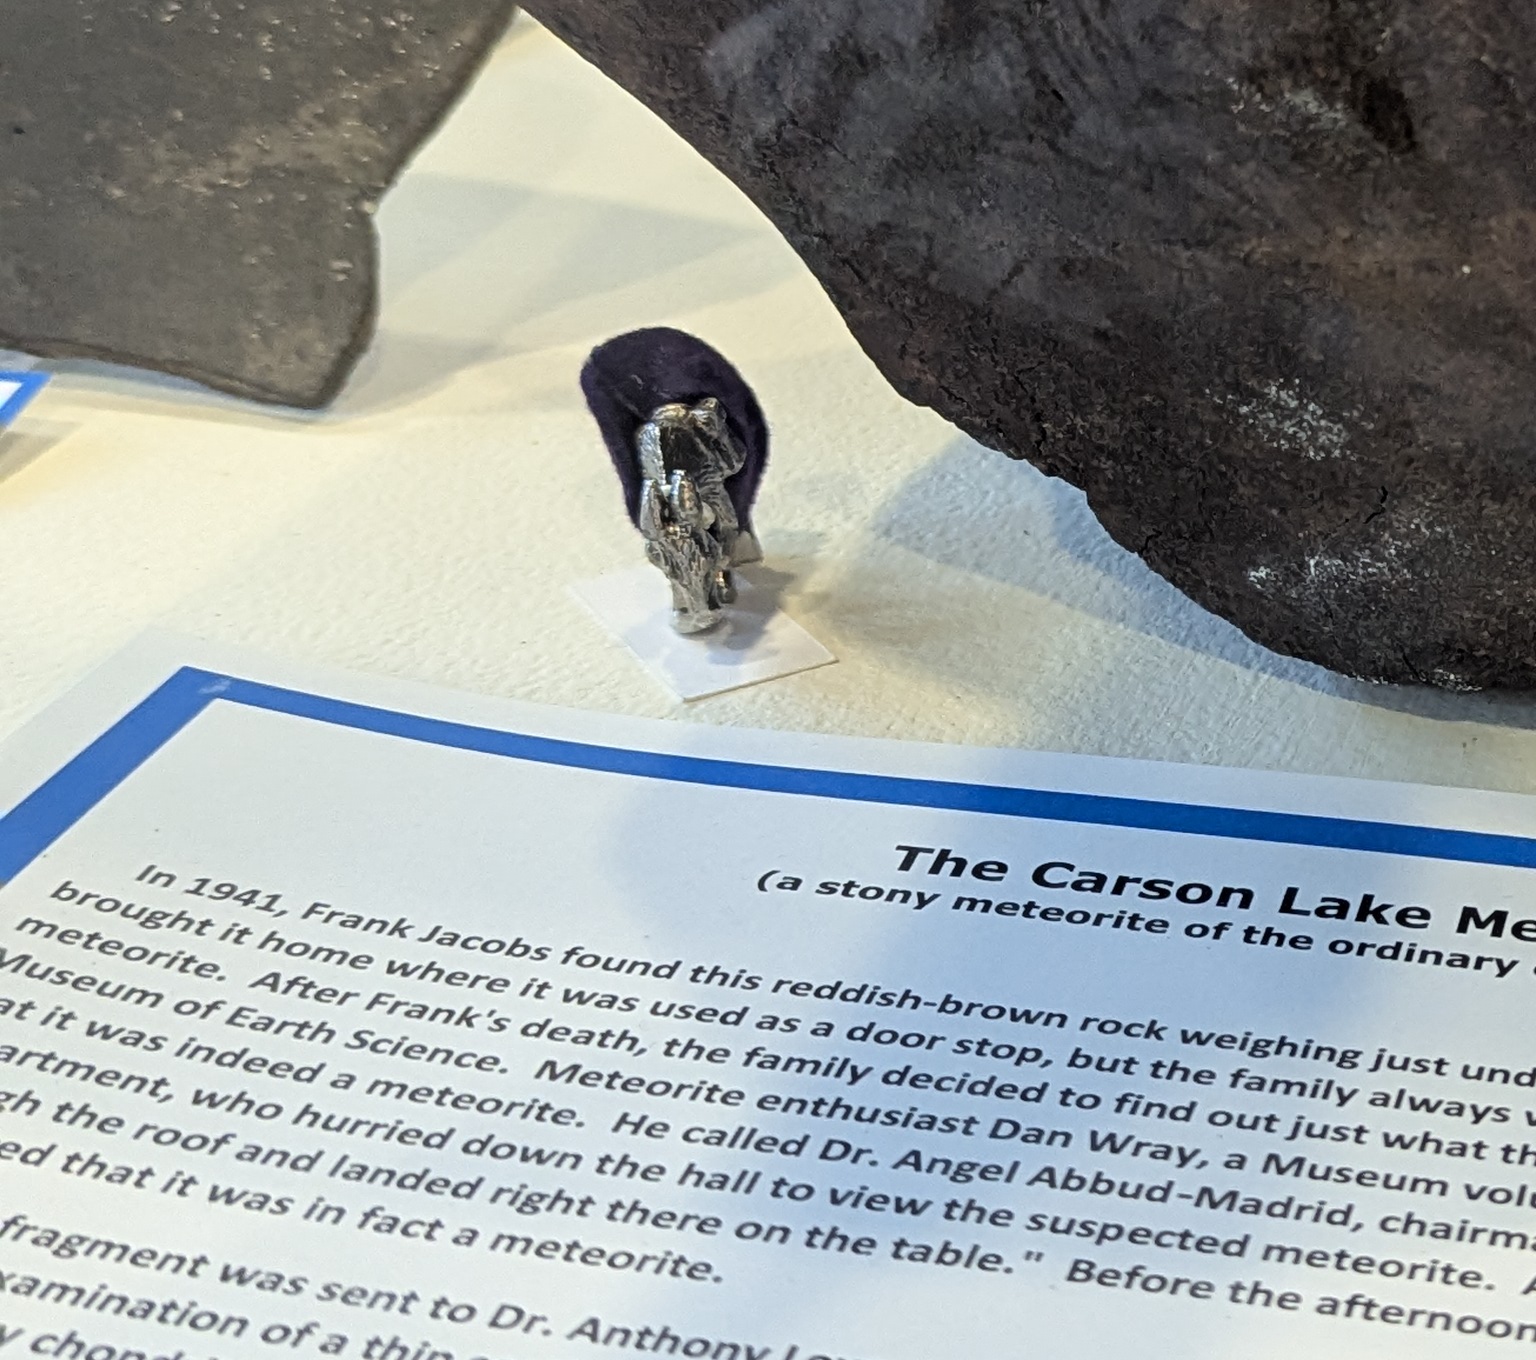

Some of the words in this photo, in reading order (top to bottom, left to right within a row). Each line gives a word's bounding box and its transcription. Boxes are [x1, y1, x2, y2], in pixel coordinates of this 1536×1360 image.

[182, 876, 289, 918] 1941,
[299, 900, 415, 939] Frank
[415, 924, 553, 962] Jacobs
[559, 945, 683, 980] found
[688, 963, 763, 991] this
[770, 978, 1069, 1029] reddish-brown
[1077, 1015, 1169, 1042] rock
[1179, 1027, 1364, 1070] weighing
[1366, 1046, 1451, 1077] just
[756, 868, 803, 893] (a
[813, 879, 942, 911] stony
[950, 894, 1170, 934] meteorite
[1182, 920, 1234, 941] of
[1241, 924, 1314, 951] the
[1326, 938, 1520, 979] ordinary
[894, 843, 1009, 882] The
[1030, 860, 1255, 911] Carson
[1276, 885, 1432, 930] Lake
[14, 916, 226, 982] meteorite.
[246, 970, 361, 1006] After
[363, 991, 512, 1033] Frank's
[519, 1017, 647, 1057] death,
[661, 1036, 731, 1064] the
[740, 1045, 875, 1086] family
[880, 1063, 1050, 1104] decided
[1112, 1091, 1198, 1123] find
[1282, 1113, 1371, 1146] just
[1381, 1129, 1490, 1161] what
[48, 879, 215, 937] brought
[255, 929, 374, 970] home
[384, 958, 511, 994] where
[561, 987, 640, 1013] was
[648, 999, 751, 1027] used
[844, 1020, 947, 1051] door
[950, 1036, 1054, 1069] stop,
[1227, 1066, 1360, 1108] family
[1366, 1086, 1511, 1126] always
[84, 1019, 169, 1052] was
[173, 1035, 327, 1084] indeed
[364, 1078, 585, 1128] meteorite.
[680, 1124, 812, 1158] called
[889, 1147, 1021, 1184] Angel
[1024, 1164, 1364, 1233] Abbud-Madrid,
[190, 1087, 284, 1120] who
[290, 1101, 456, 1150] hurried
[460, 1132, 583, 1171] down
[676, 1161, 763, 1195] hall
[828, 1183, 934, 1217] view
[1023, 1212, 1252, 1258] suspected
[1260, 1242, 1495, 1291] meteorite.
[223, 1005, 337, 1045] Earth
[342, 1028, 508, 1075] Science.
[533, 1058, 746, 1107] Meteorite
[755, 1093, 981, 1137] enthusiast
[986, 1116, 1074, 1148] Dan
[1088, 1128, 1209, 1170] Wray,
[1260, 1151, 1449, 1197] Museum
[0, 1213, 210, 1278] fragment
[315, 1281, 420, 1315] sent
[59, 1151, 156, 1189] that
[356, 1204, 445, 1242] fact
[488, 1232, 723, 1283] meteorite.
[131, 1122, 237, 1156] roof
[233, 1143, 325, 1173] and
[327, 1153, 486, 1200] landed
[488, 1182, 596, 1218] right
[604, 1198, 723, 1236] there
[889, 1236, 1044, 1274] table."
[1064, 1257, 1216, 1300] Before
